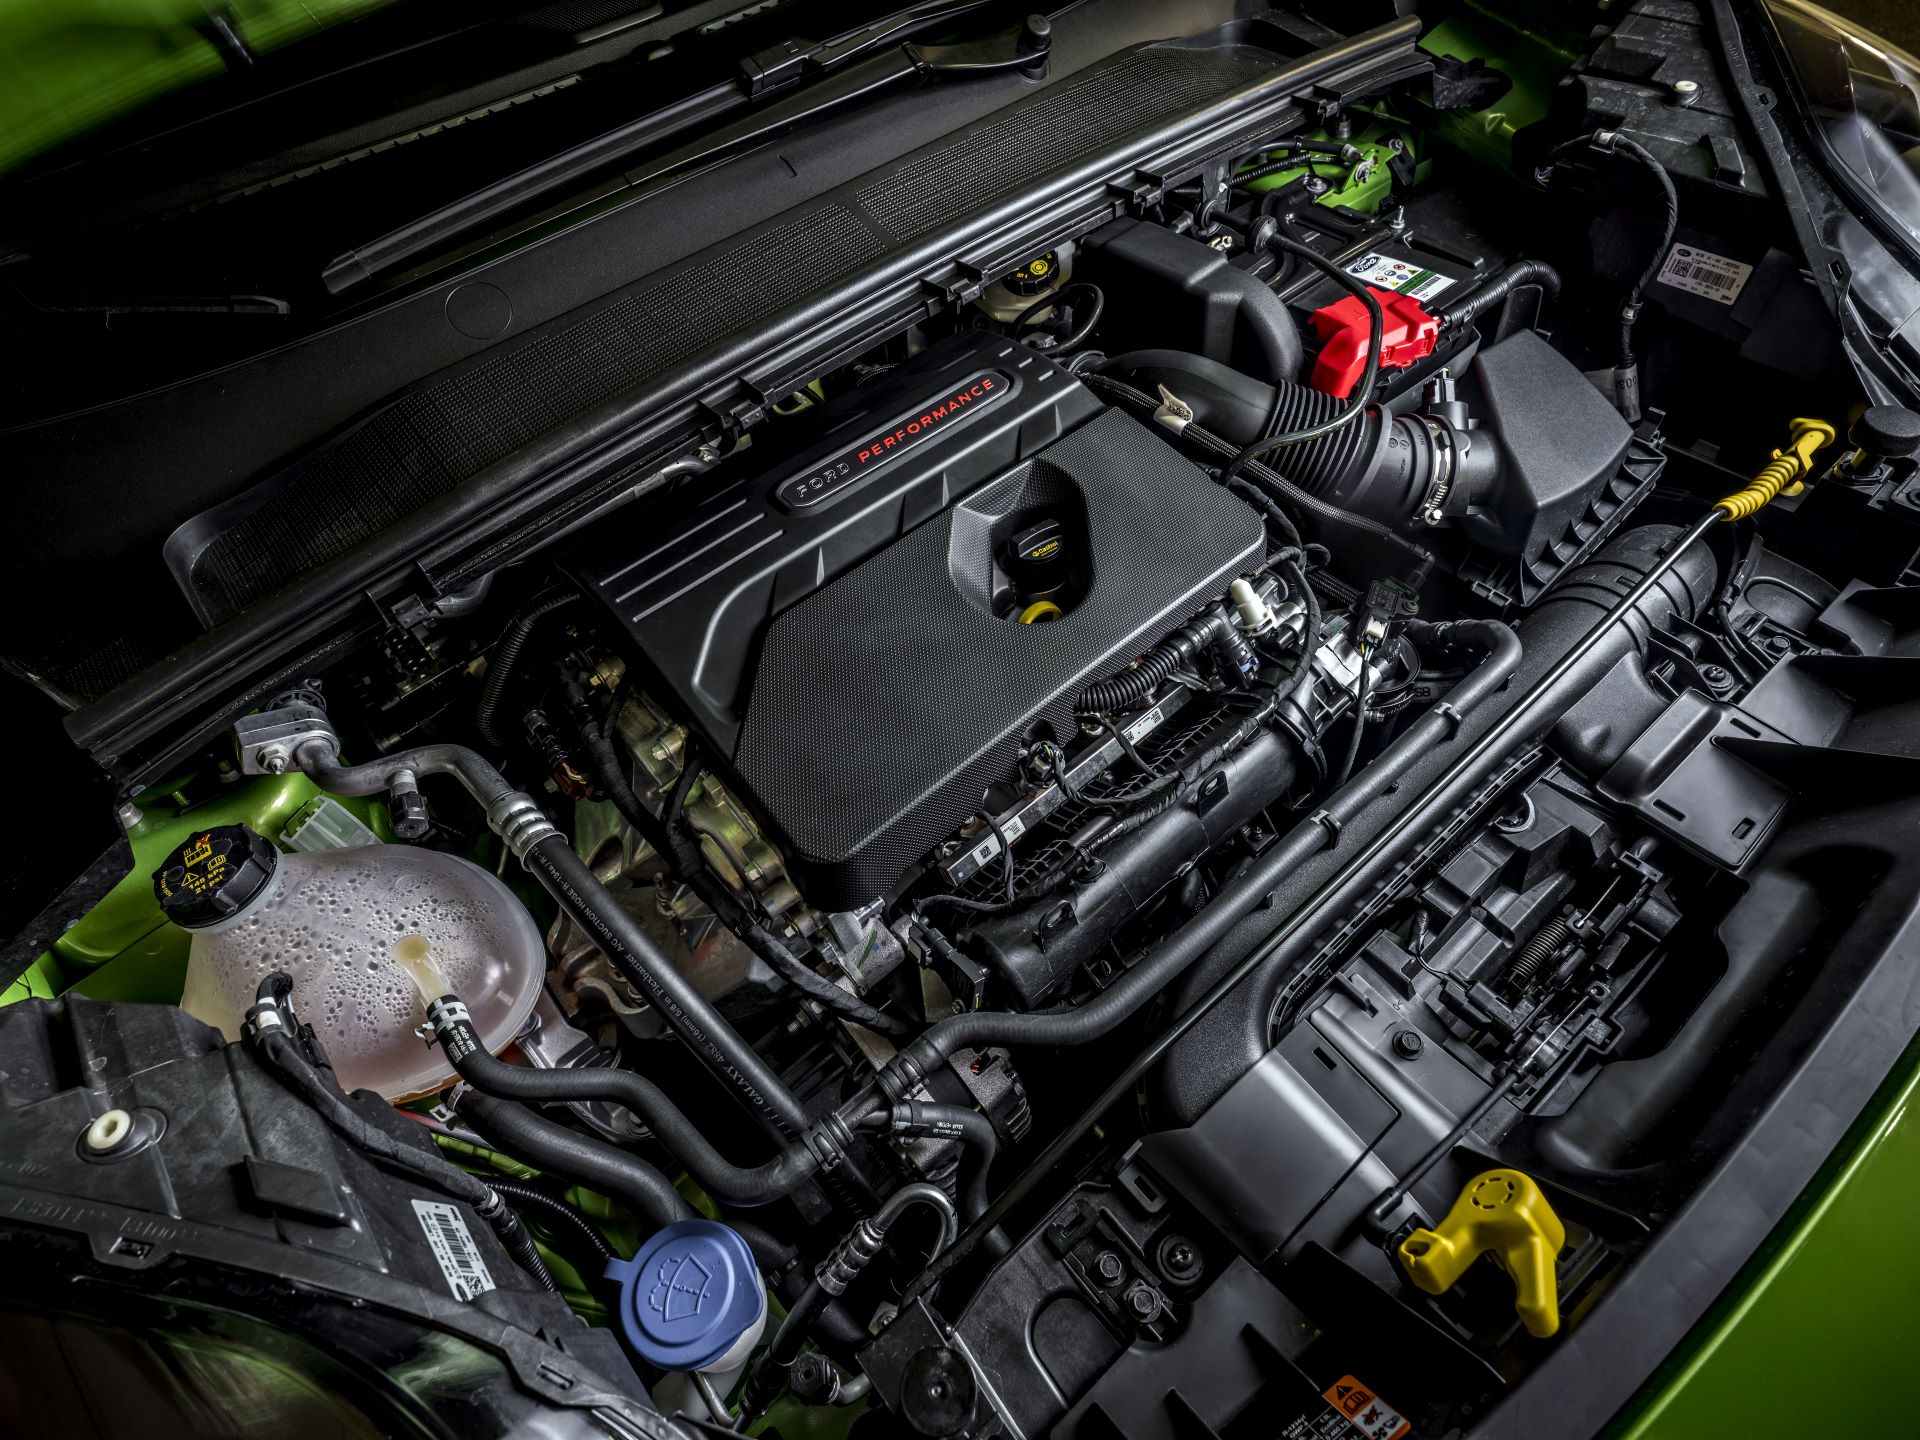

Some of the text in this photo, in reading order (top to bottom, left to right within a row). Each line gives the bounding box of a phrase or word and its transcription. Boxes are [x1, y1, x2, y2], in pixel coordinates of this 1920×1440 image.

[796, 378, 995, 498] FORD PERFORMANCE
[1038, 540, 1059, 554] Castrol
[548, 864, 570, 891] R-134a
[567, 888, 586, 909] HOSE
[584, 907, 613, 940] SUCTION
[610, 938, 625, 952] A/C
[625, 952, 664, 997] Flexbarrier
[664, 995, 672, 1006] in
[680, 1015, 706, 1043] (16mm)
[705, 1042, 725, 1063] 4882
[725, 1065, 764, 1105] GALAXY
